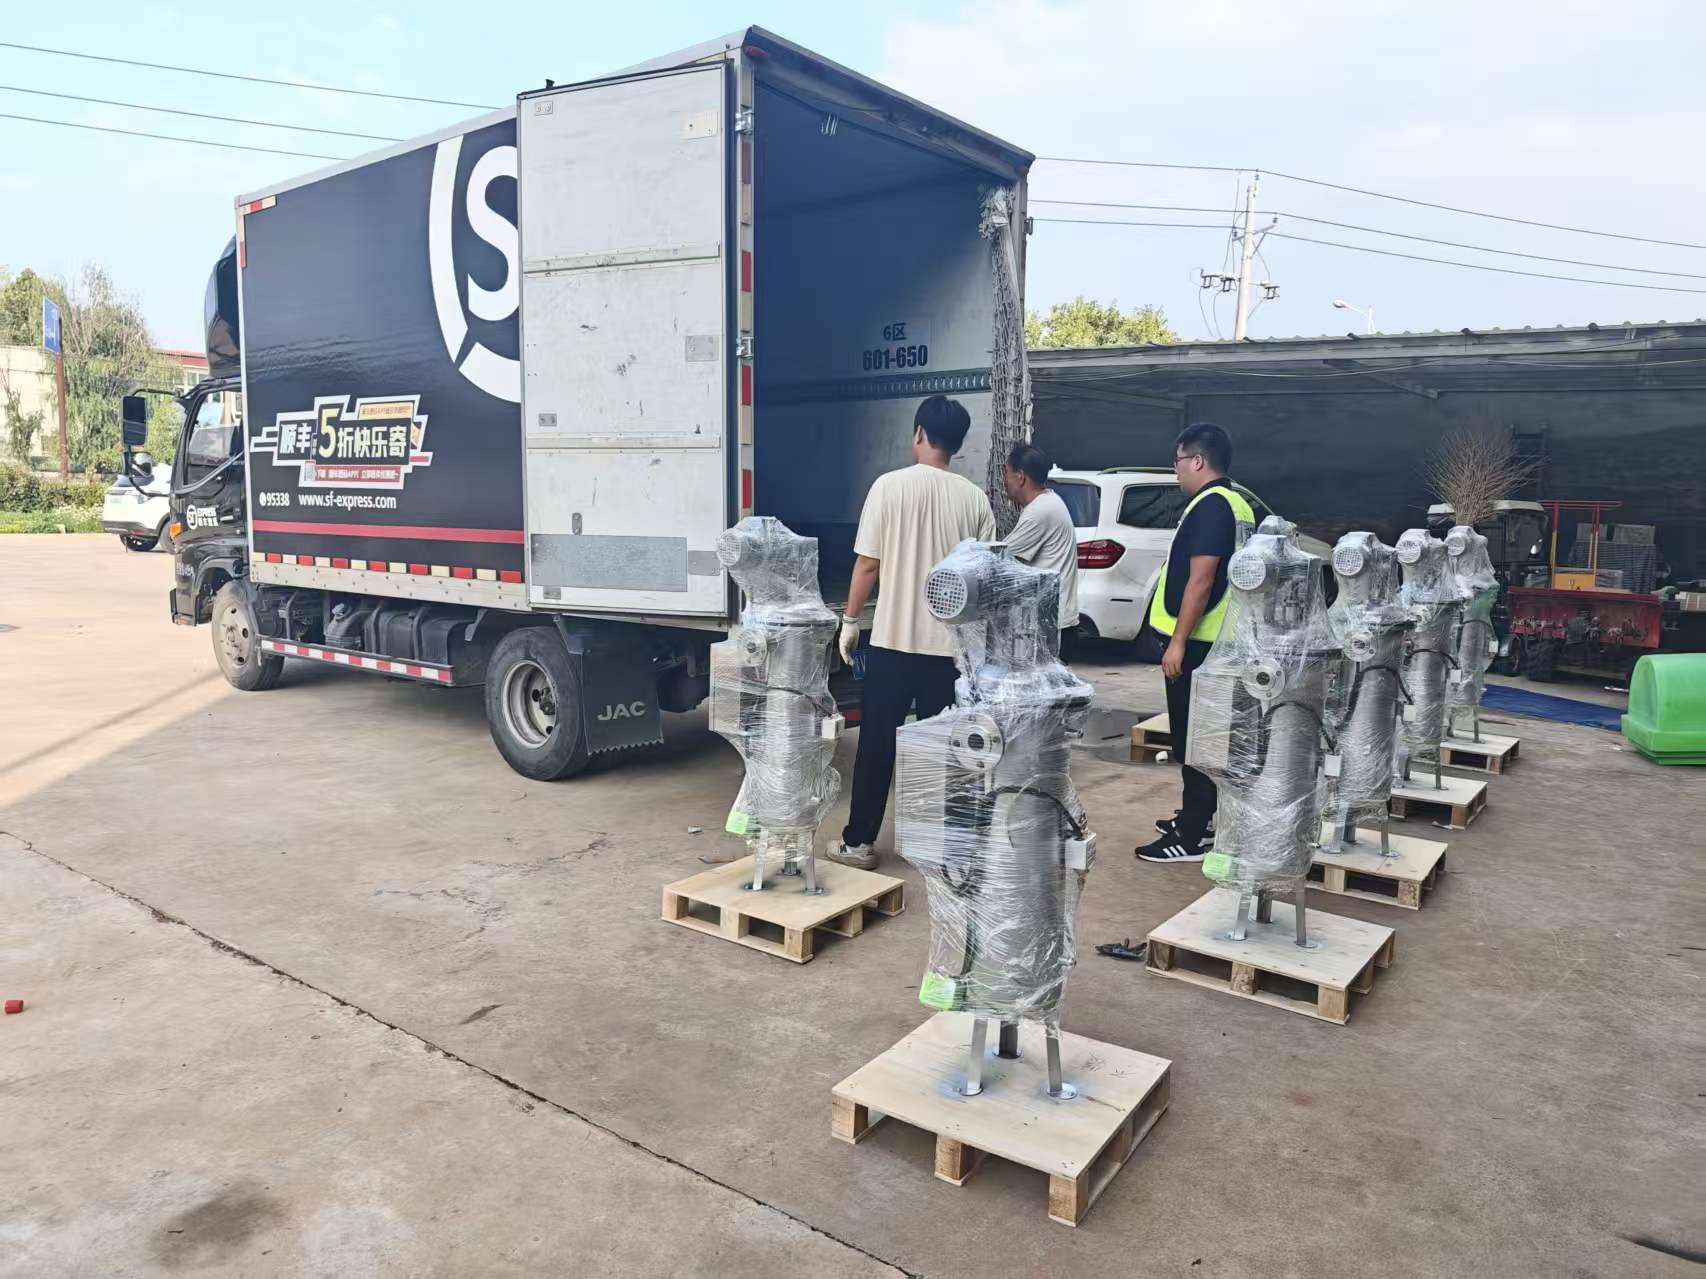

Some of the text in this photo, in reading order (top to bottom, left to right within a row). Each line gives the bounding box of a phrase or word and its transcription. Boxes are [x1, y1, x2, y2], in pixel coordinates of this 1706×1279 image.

[883, 322, 907, 341] 6区
[862, 344, 928, 371] 601-650
[266, 491, 397, 511] 95338 www.sf-express.com
[597, 701, 646, 720] JAC
